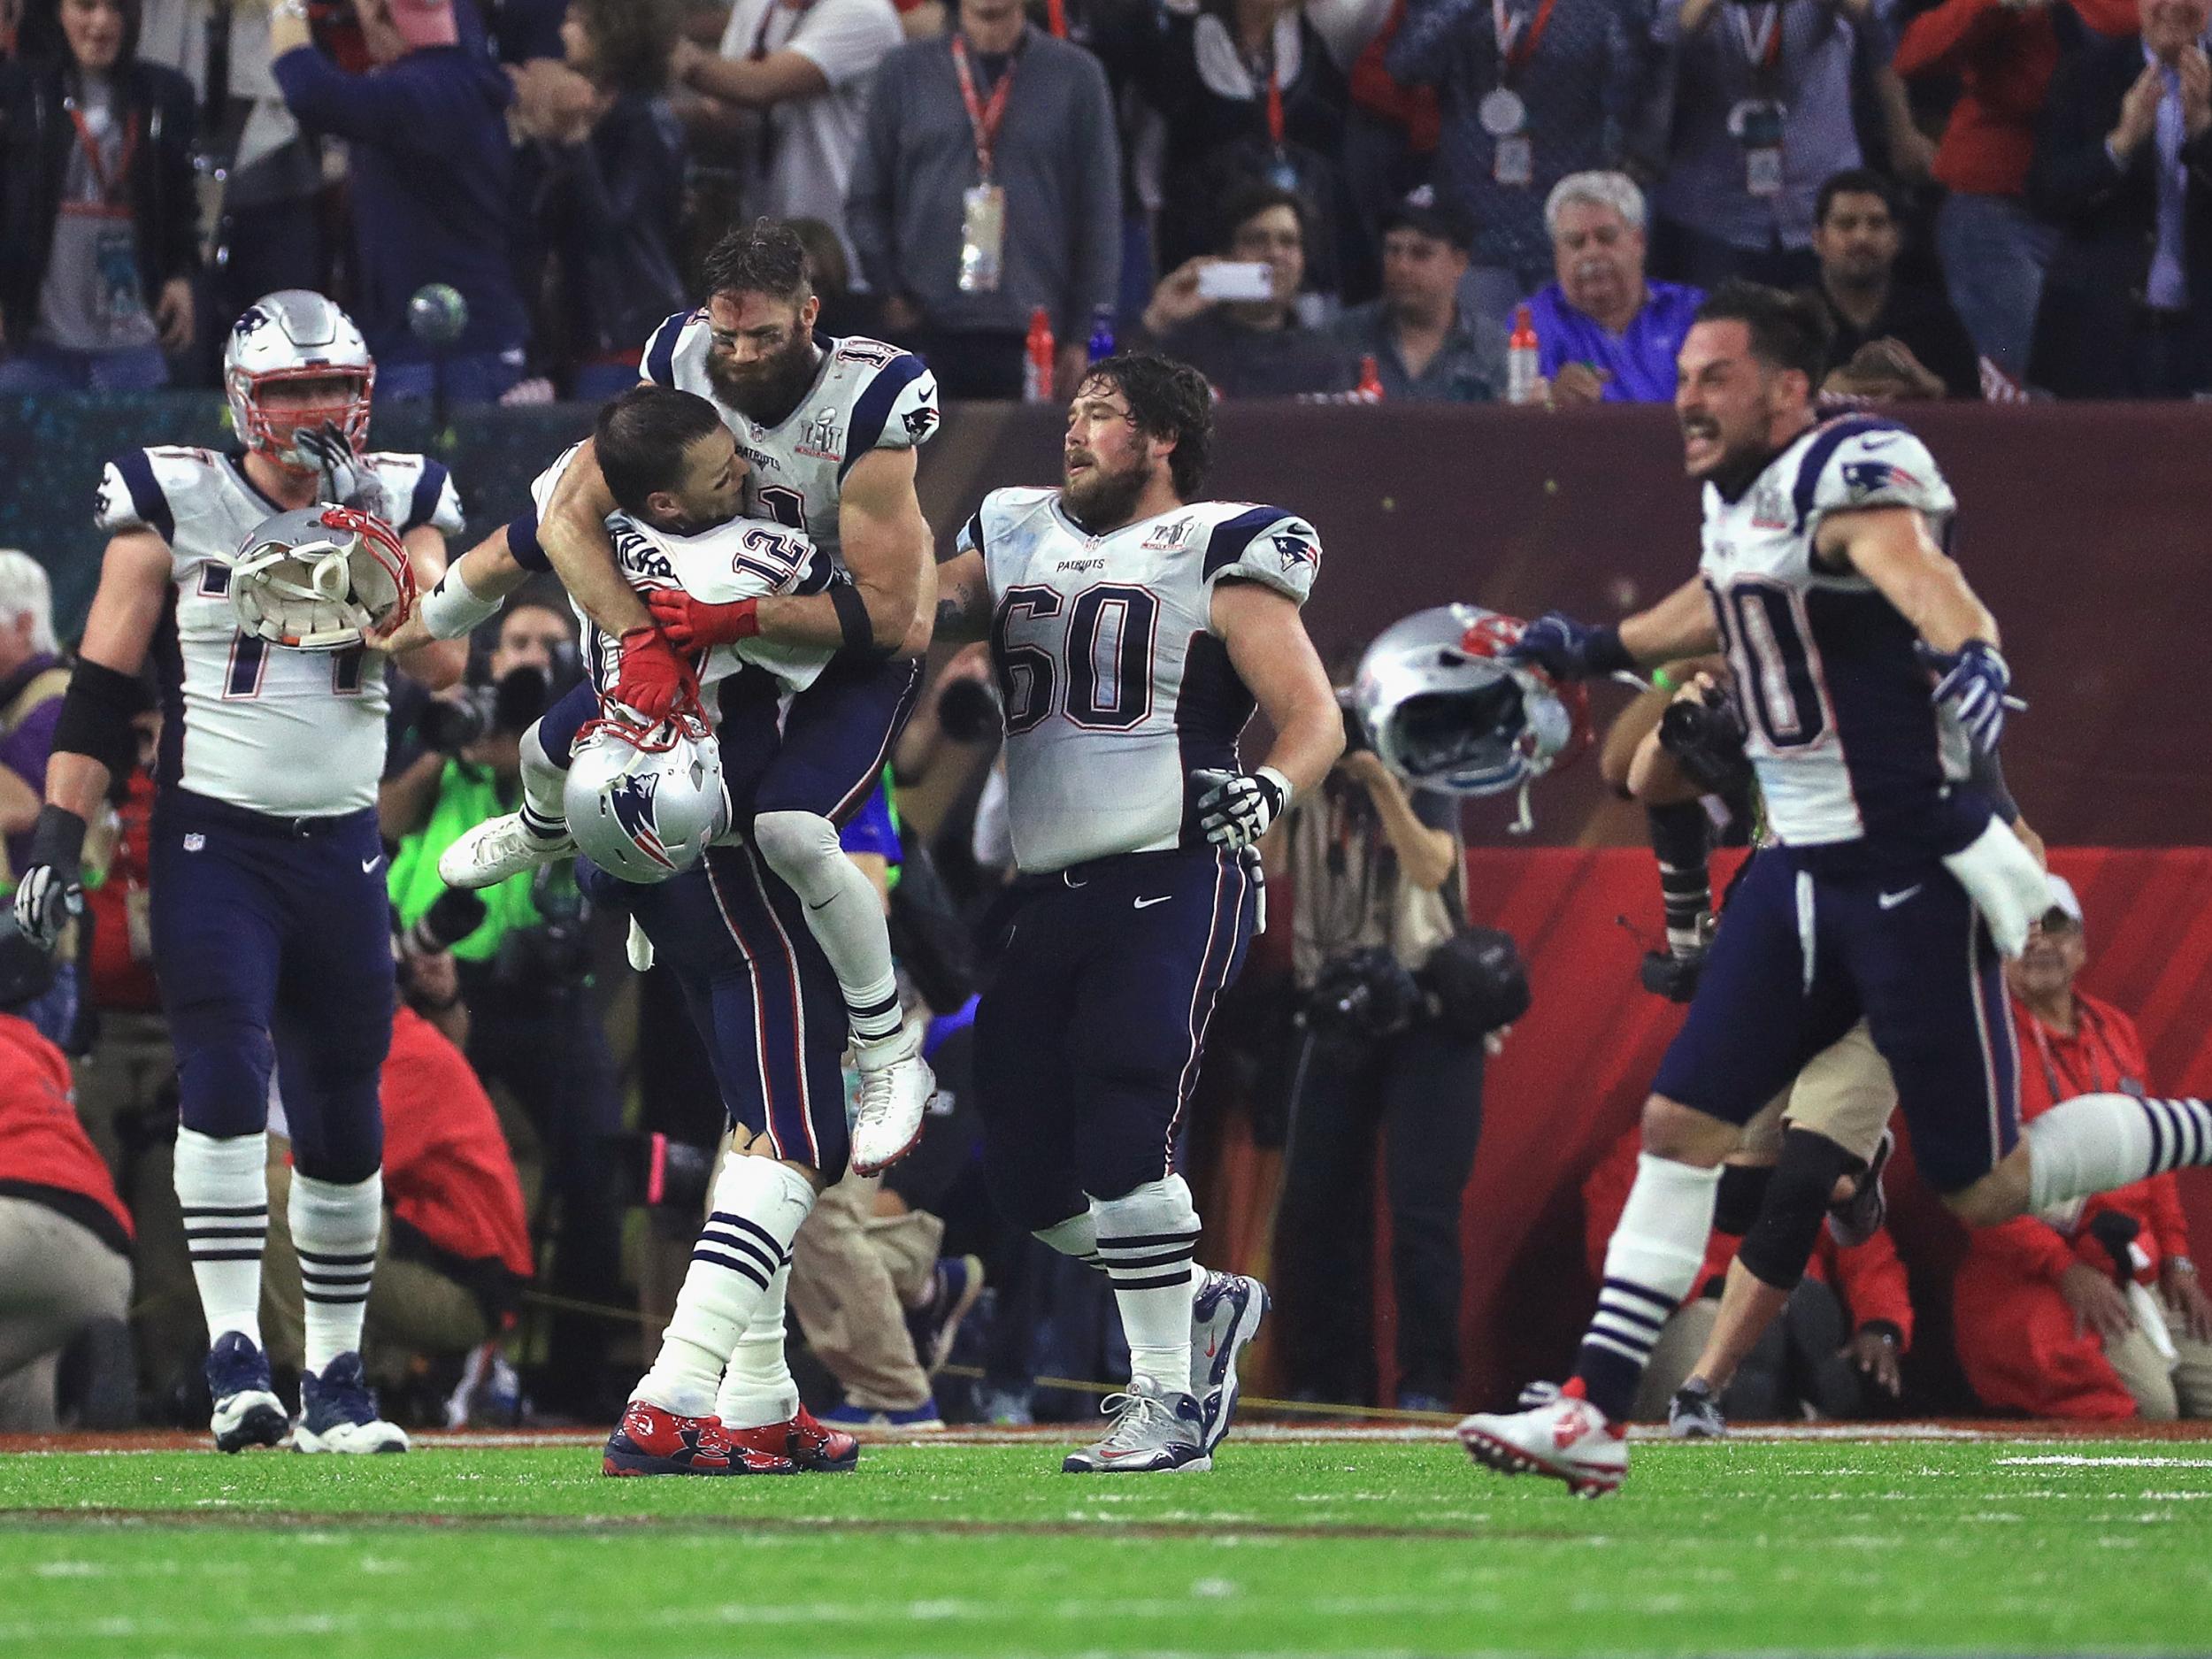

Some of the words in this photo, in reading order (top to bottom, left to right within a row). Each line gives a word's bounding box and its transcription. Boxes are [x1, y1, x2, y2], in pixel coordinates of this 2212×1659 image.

[733, 527, 809, 591] 12
[1056, 558, 1105, 572] PATRIOTS
[990, 581, 1161, 737] 60
